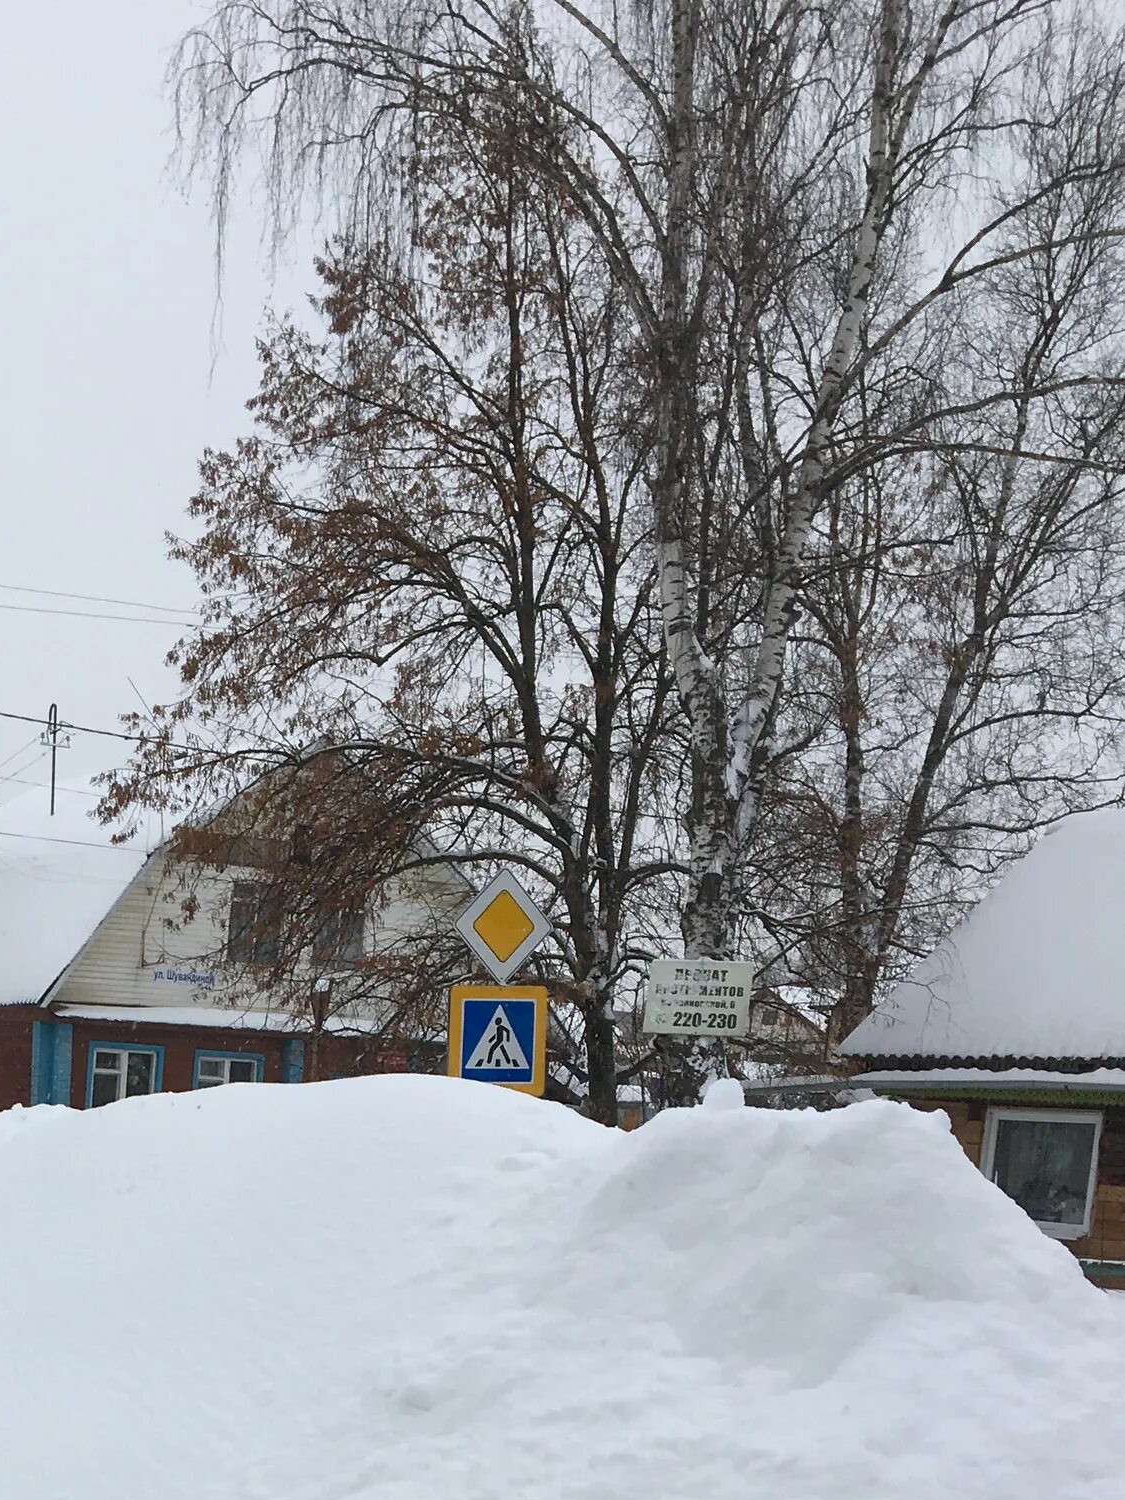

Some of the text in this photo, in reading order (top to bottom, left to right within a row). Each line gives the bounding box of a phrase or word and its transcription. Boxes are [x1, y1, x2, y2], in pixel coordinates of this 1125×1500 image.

[153, 970, 165, 982] ул.
[655, 983, 745, 998] ИНСТРМЕНТОВ
[672, 1011, 738, 1029] 220-230
